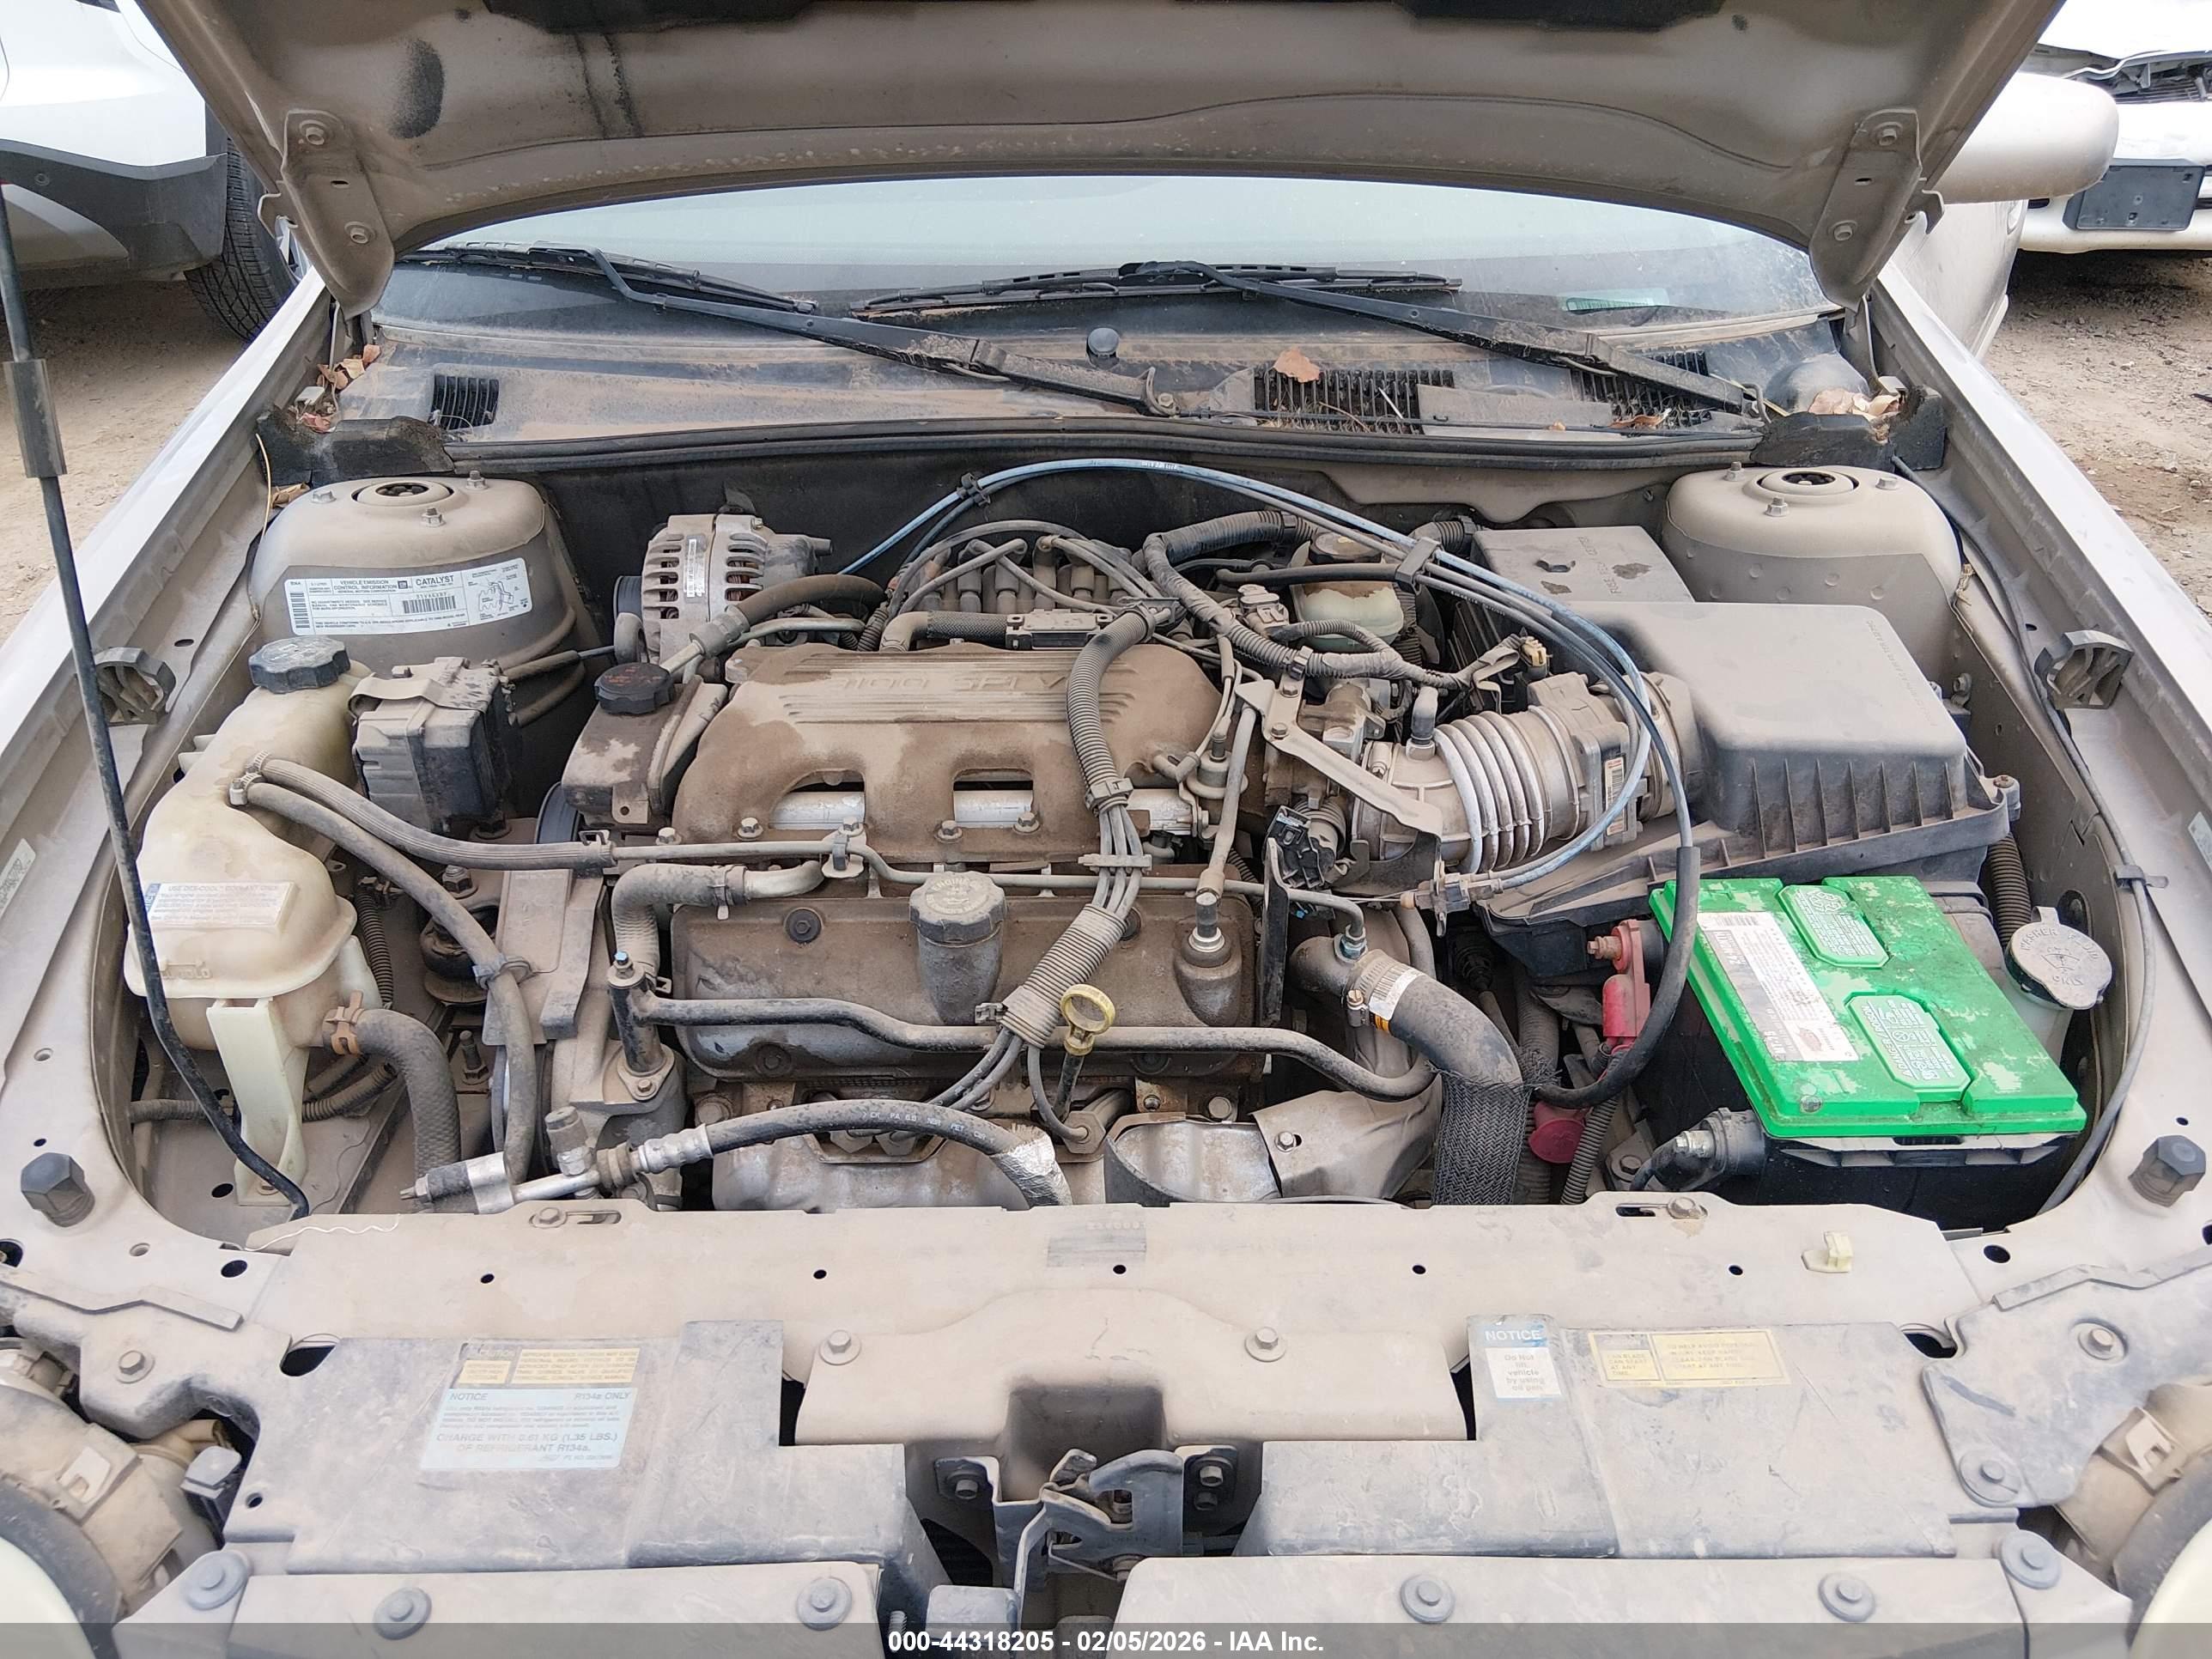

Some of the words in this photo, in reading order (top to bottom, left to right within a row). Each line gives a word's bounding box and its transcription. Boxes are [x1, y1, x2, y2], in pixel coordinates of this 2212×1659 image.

[416, 574, 454, 586] CATALYST
[2020, 927, 2057, 951] WASHER
[1485, 1330, 1540, 1340] NOTICE
[436, 1433, 484, 1442] CHARGE
[590, 1432, 618, 1442] LBS.)
[475, 1443, 555, 1452] REFRIGERANT
